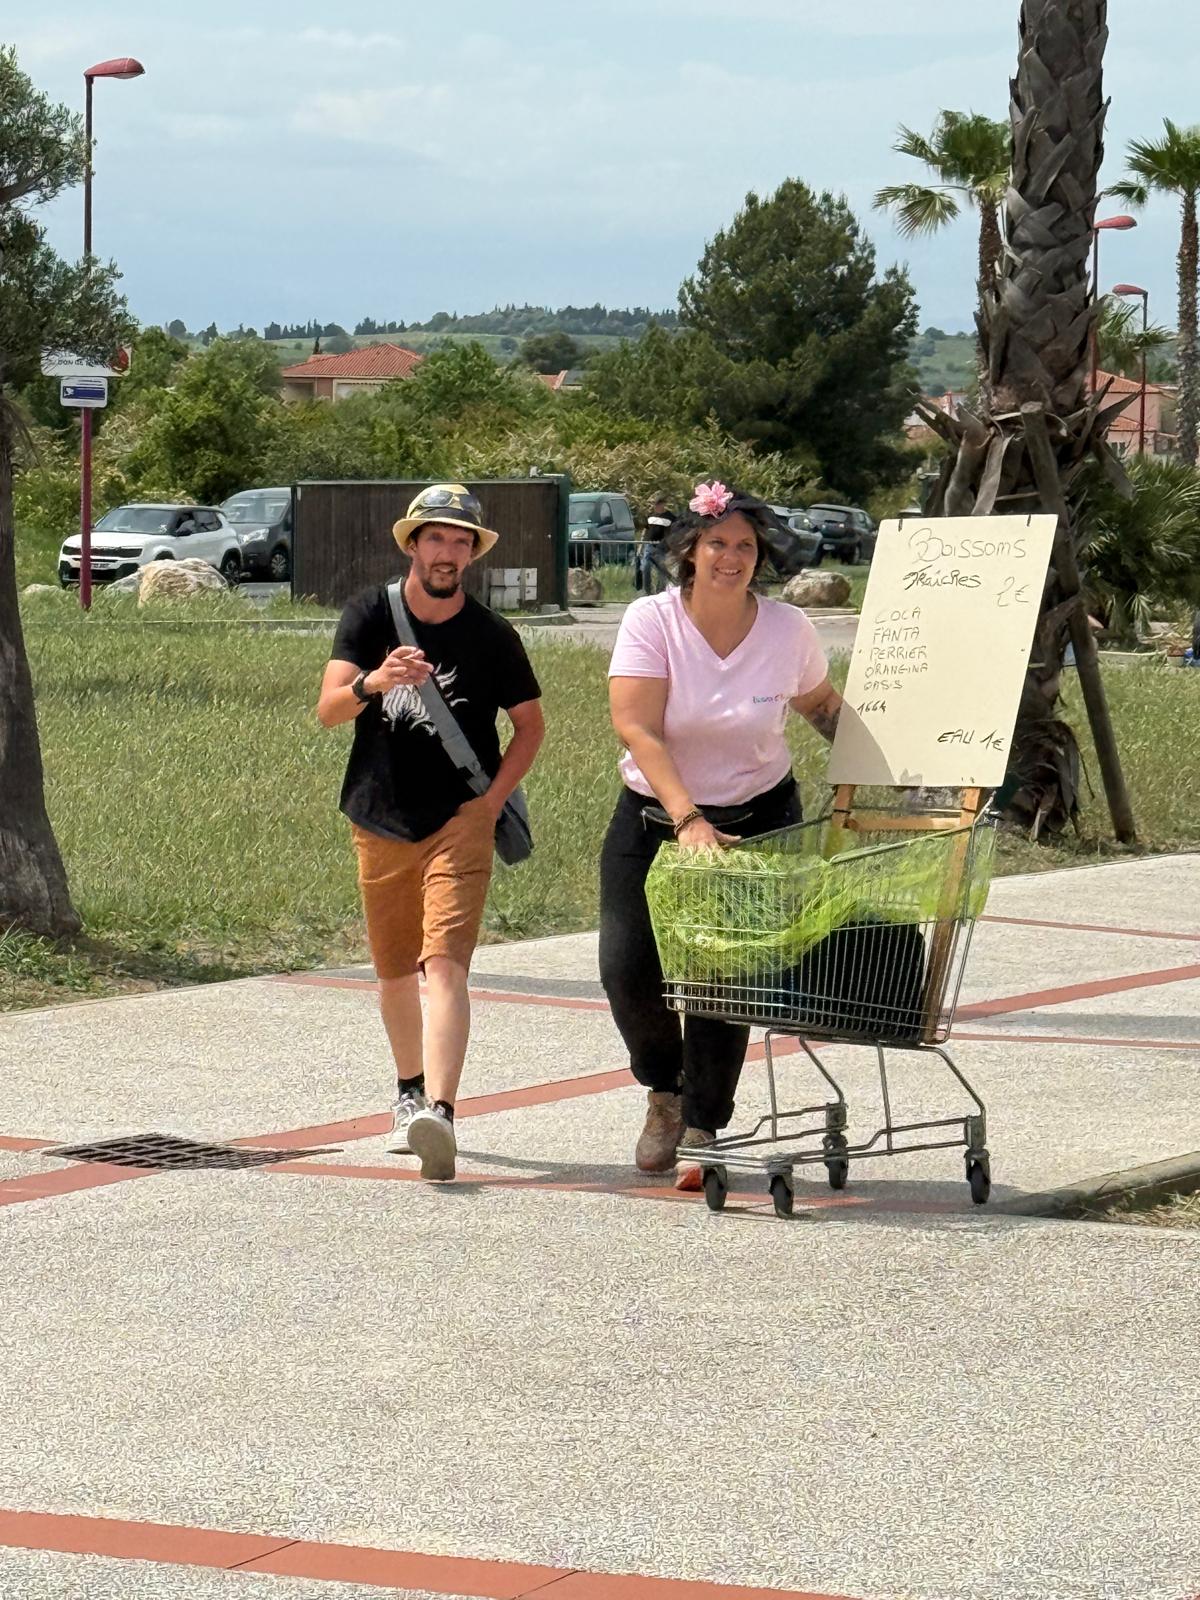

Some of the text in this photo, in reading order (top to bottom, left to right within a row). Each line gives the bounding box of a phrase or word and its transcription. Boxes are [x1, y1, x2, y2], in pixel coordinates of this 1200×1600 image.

[875, 606, 921, 624] COCA
[872, 626, 920, 644] FANTA
[870, 645, 927, 661] PERRIER
[857, 700, 887, 716] 1664
[937, 728, 1005, 751] EAU 1€
